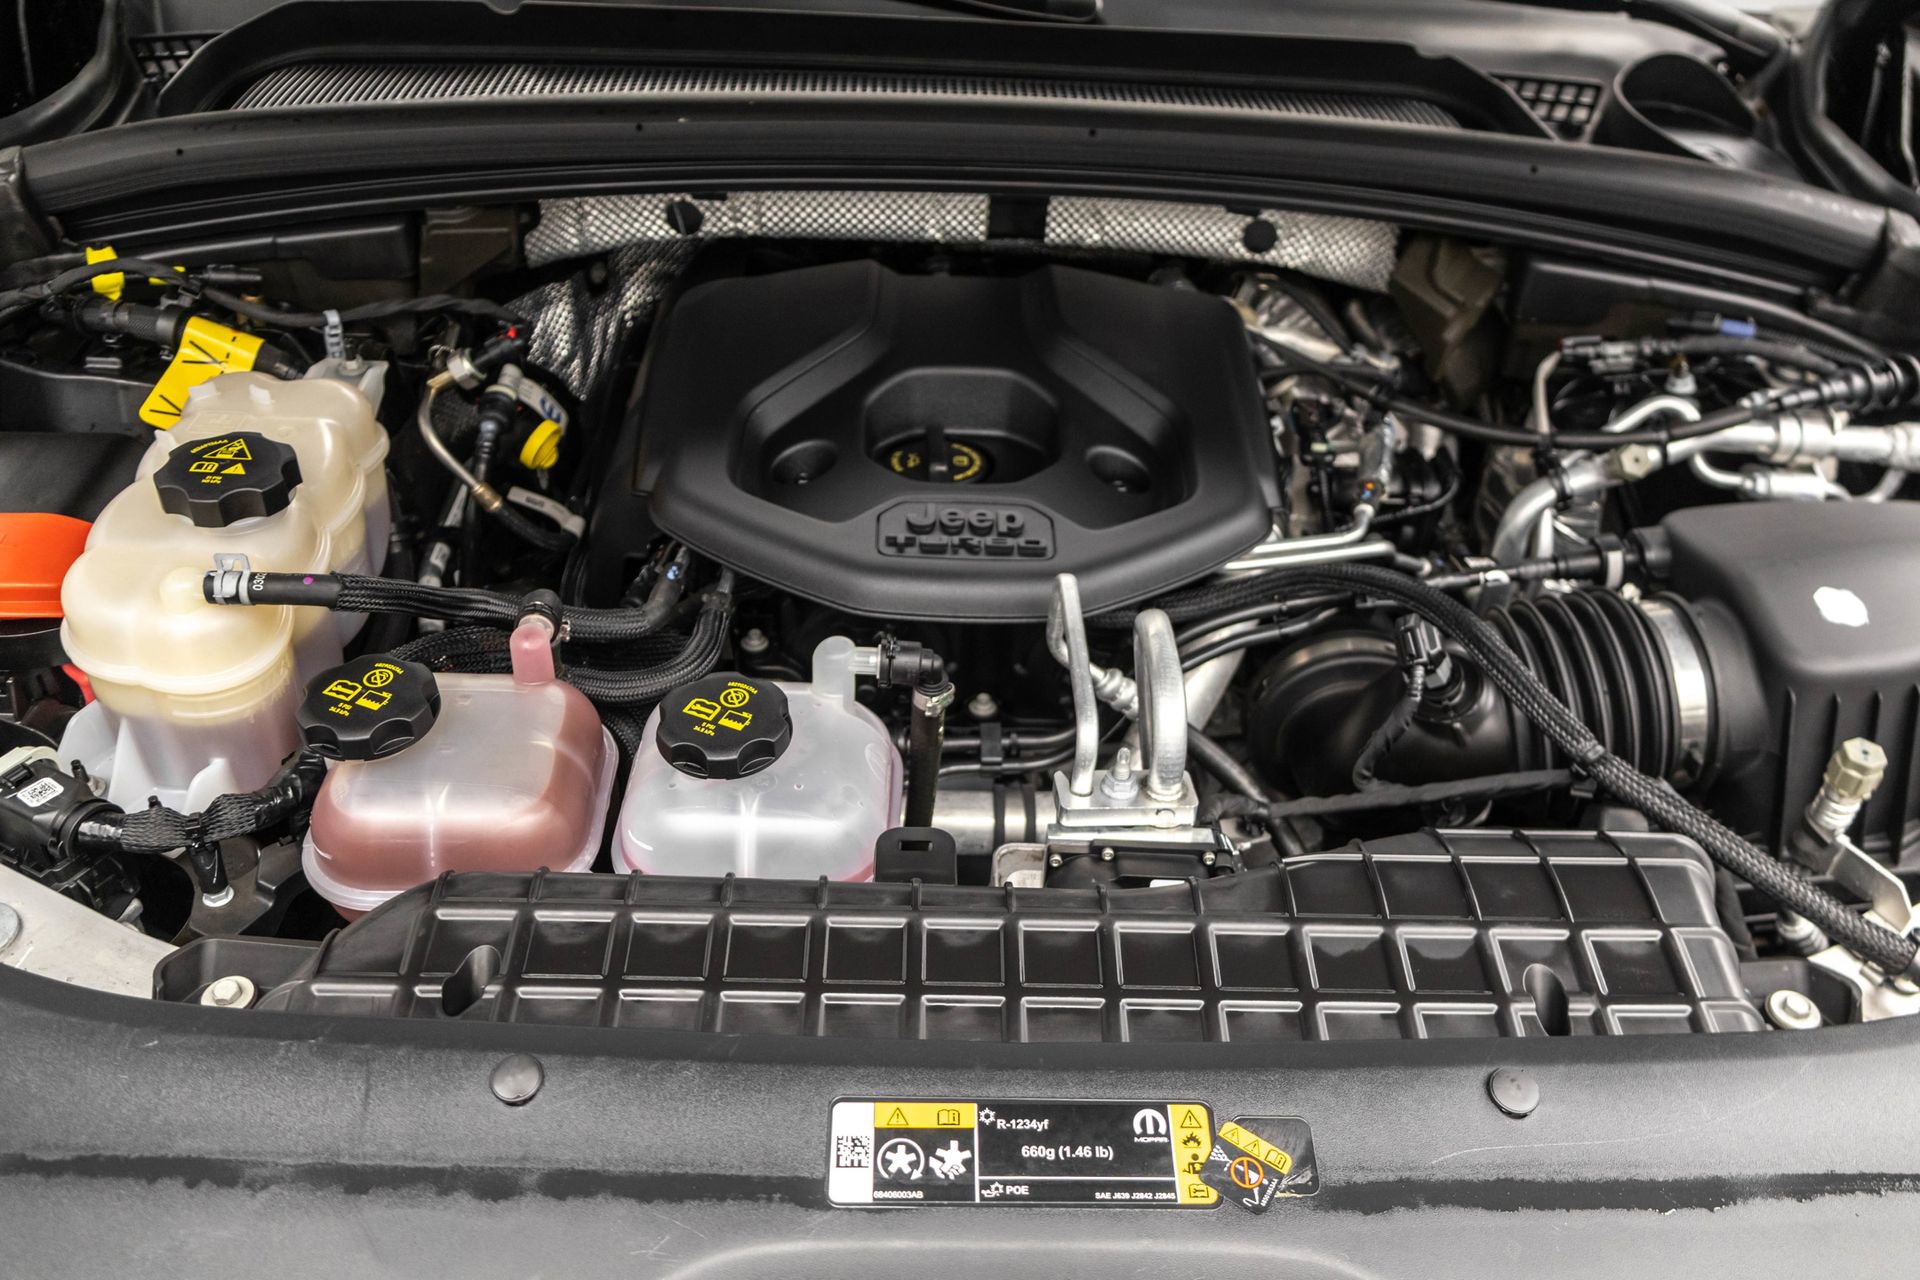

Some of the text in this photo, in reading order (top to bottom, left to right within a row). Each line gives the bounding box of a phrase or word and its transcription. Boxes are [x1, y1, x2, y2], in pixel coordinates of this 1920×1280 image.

[906, 503, 1025, 537] Jeep
[885, 535, 1048, 557] TURBO
[996, 1118, 1049, 1132] R-1234yf
[1021, 1145, 1114, 1160] 660g (1.46 lb)
[1006, 1186, 1029, 1195] POE
